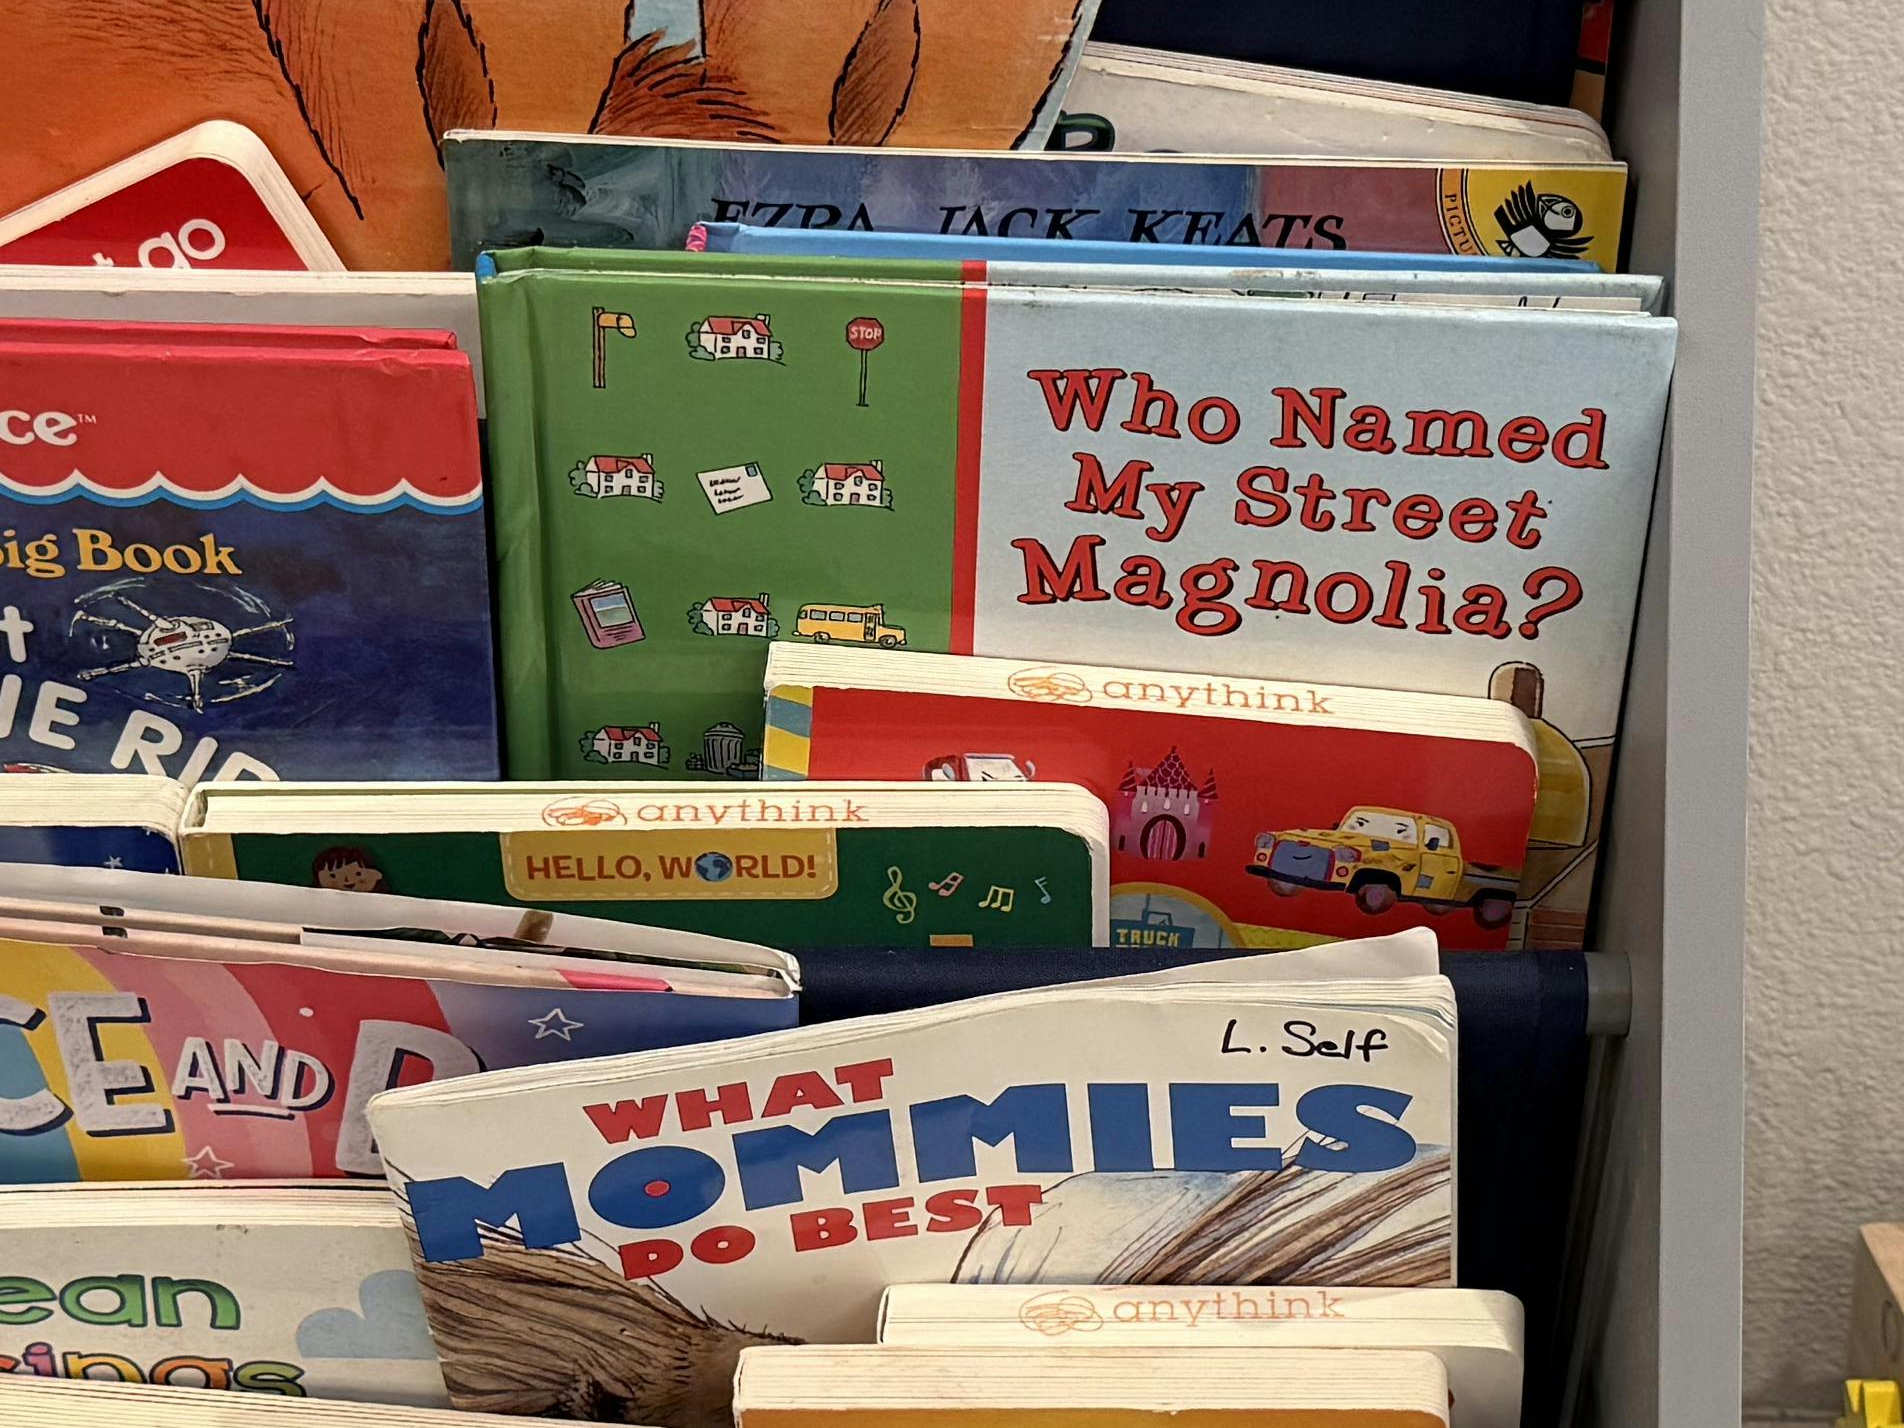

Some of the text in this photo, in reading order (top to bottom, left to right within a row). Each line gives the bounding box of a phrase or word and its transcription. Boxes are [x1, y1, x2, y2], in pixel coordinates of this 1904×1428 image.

[1444, 192, 1481, 256] PICTU
[848, 325, 882, 340] STOP
[1027, 367, 1610, 470] Who Named
[1064, 452, 1548, 550] My Street
[71, 528, 242, 575] Book
[1010, 534, 1585, 640] Magnolia?
[1101, 674, 1335, 718] anythink
[637, 796, 870, 826] anythink
[525, 853, 652, 884] HELLO,
[1117, 928, 1181, 947] TRUCK
[1220, 1018, 1390, 1062] L. Self
[170, 1035, 335, 1117] AND
[582, 1058, 894, 1144] WHAT
[404, 1082, 1417, 1263] MOMMIES
[617, 1184, 1043, 1281] DO BEST
[1111, 1290, 1346, 1329] anythink
